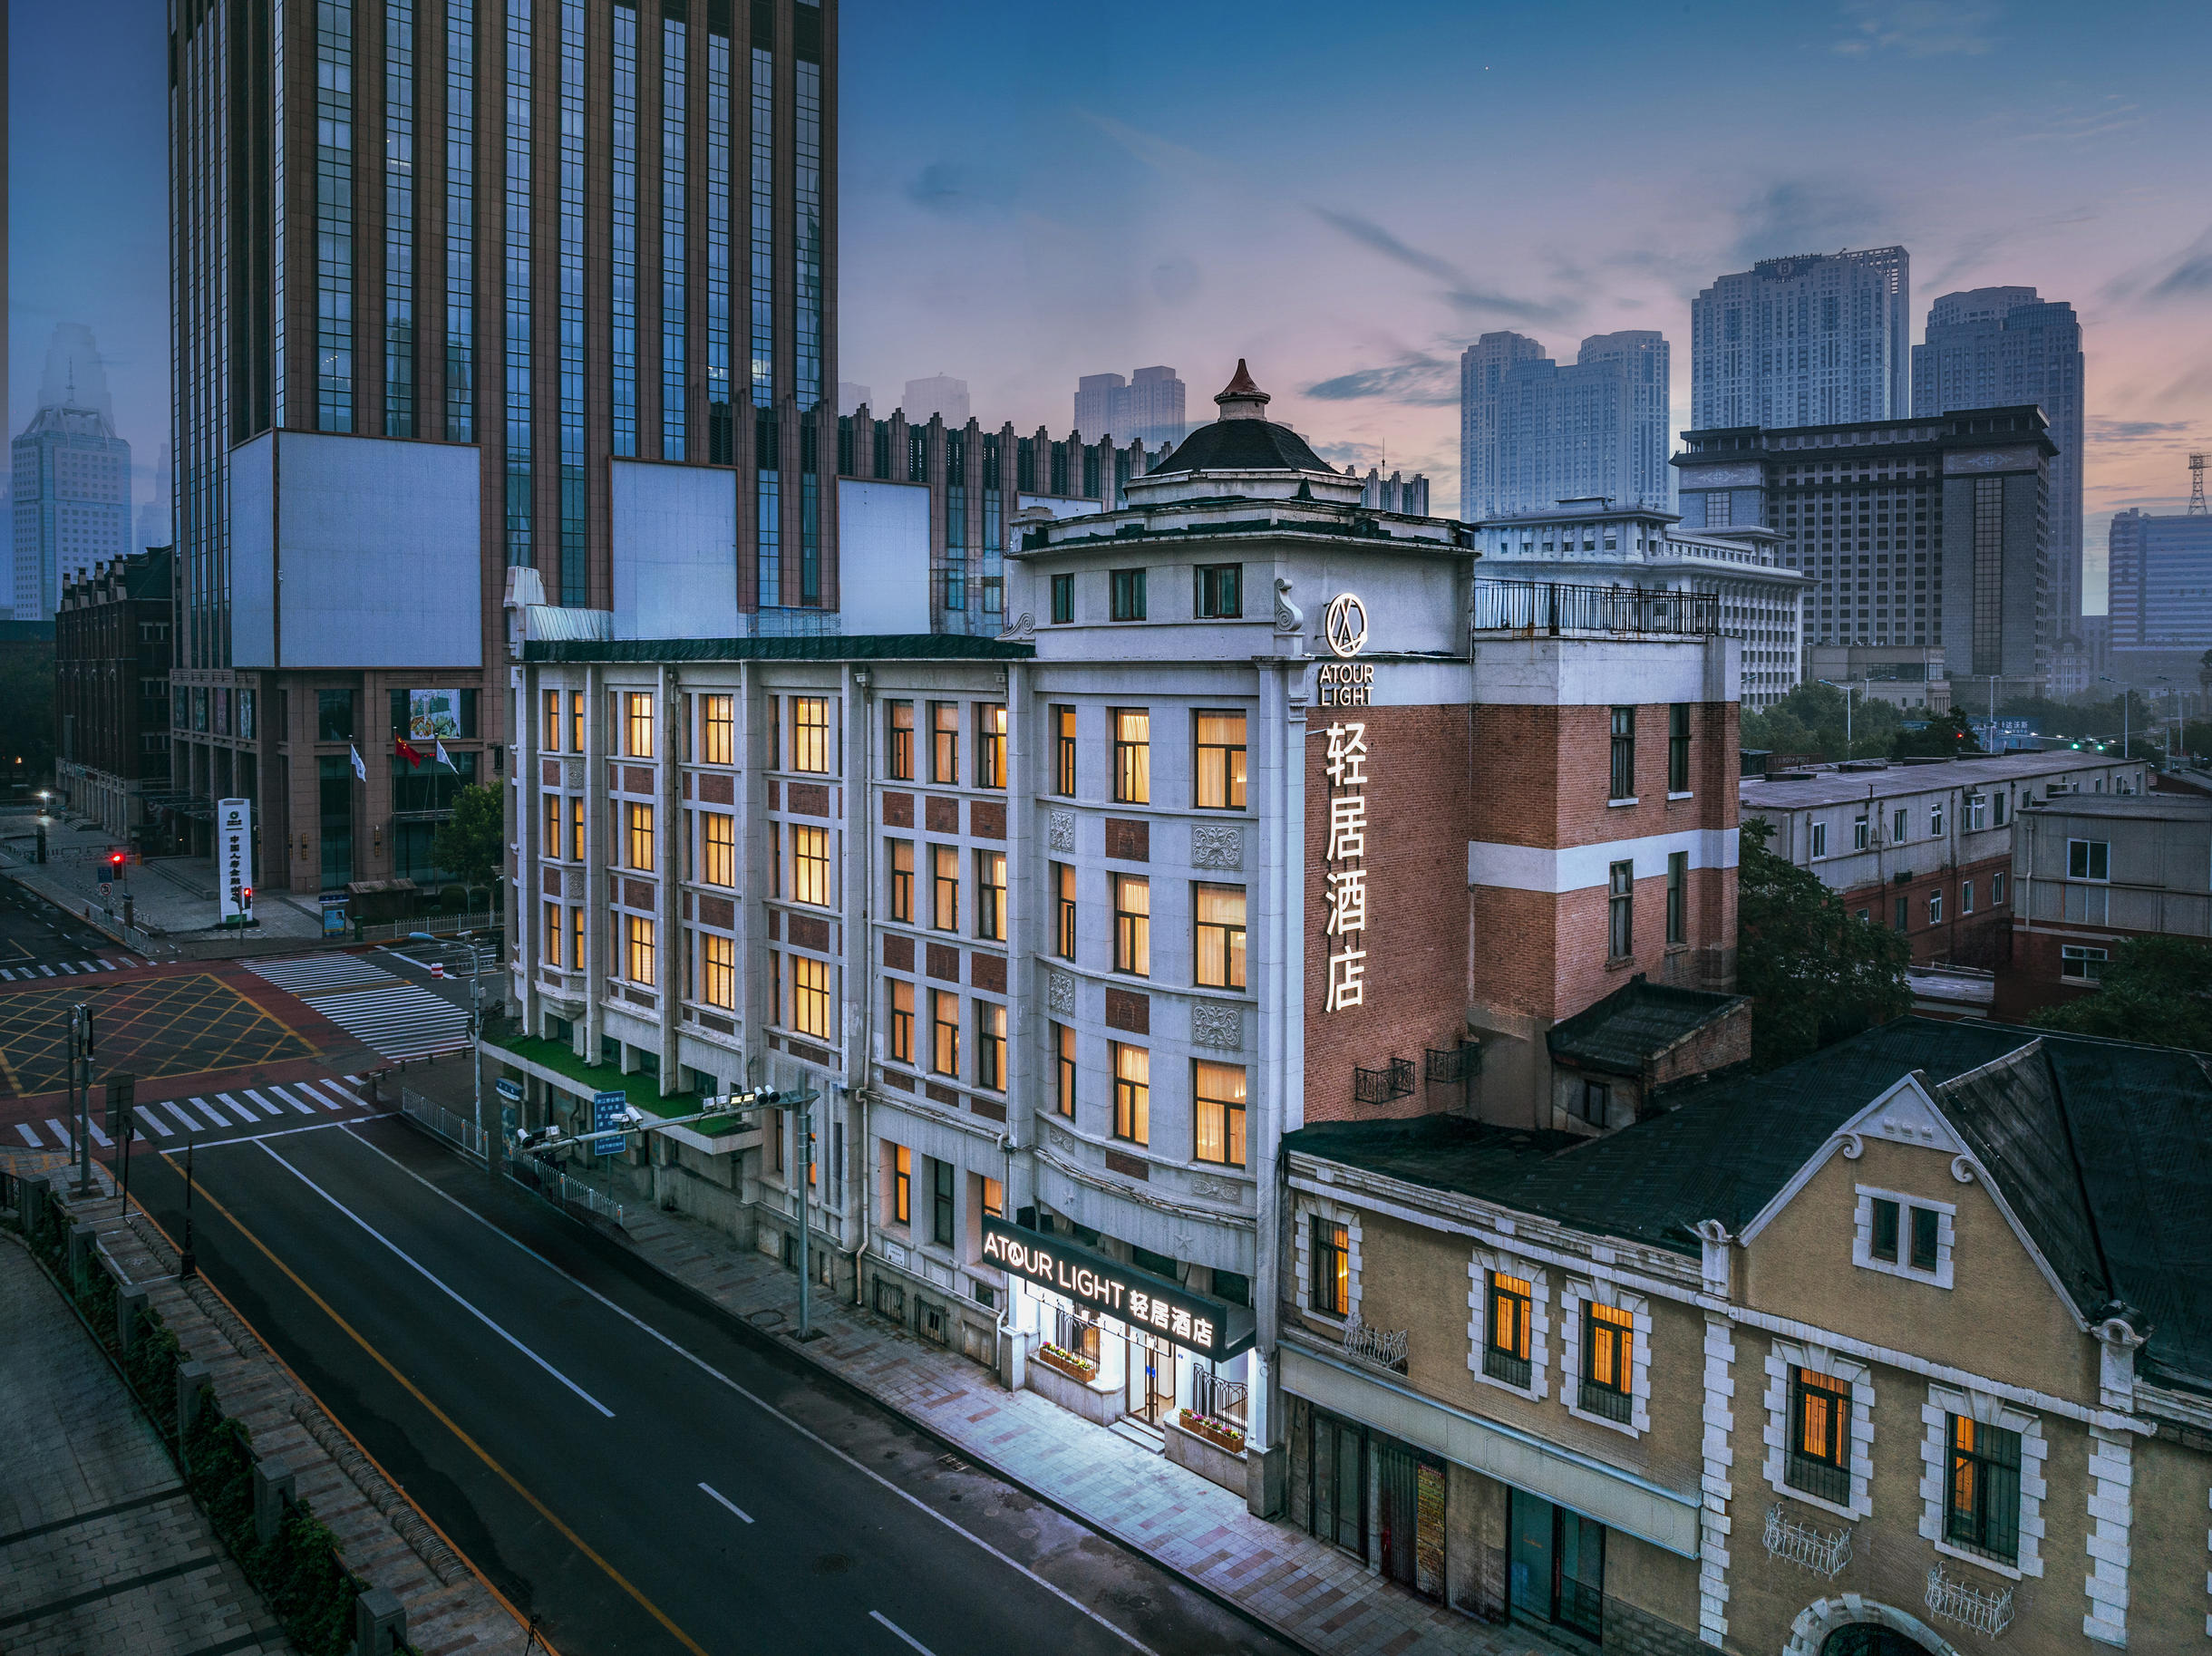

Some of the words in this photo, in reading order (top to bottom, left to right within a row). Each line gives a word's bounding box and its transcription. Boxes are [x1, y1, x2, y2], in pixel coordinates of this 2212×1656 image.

[1320, 664, 1374, 683] ATOUR
[1321, 686, 1374, 706] LIGHT
[1325, 721, 1367, 1013] 轻居酒店
[984, 1232, 1053, 1282] ATOUR
[1058, 1260, 1125, 1310] LIGHT
[1129, 1289, 1214, 1349] 轻居酒店
